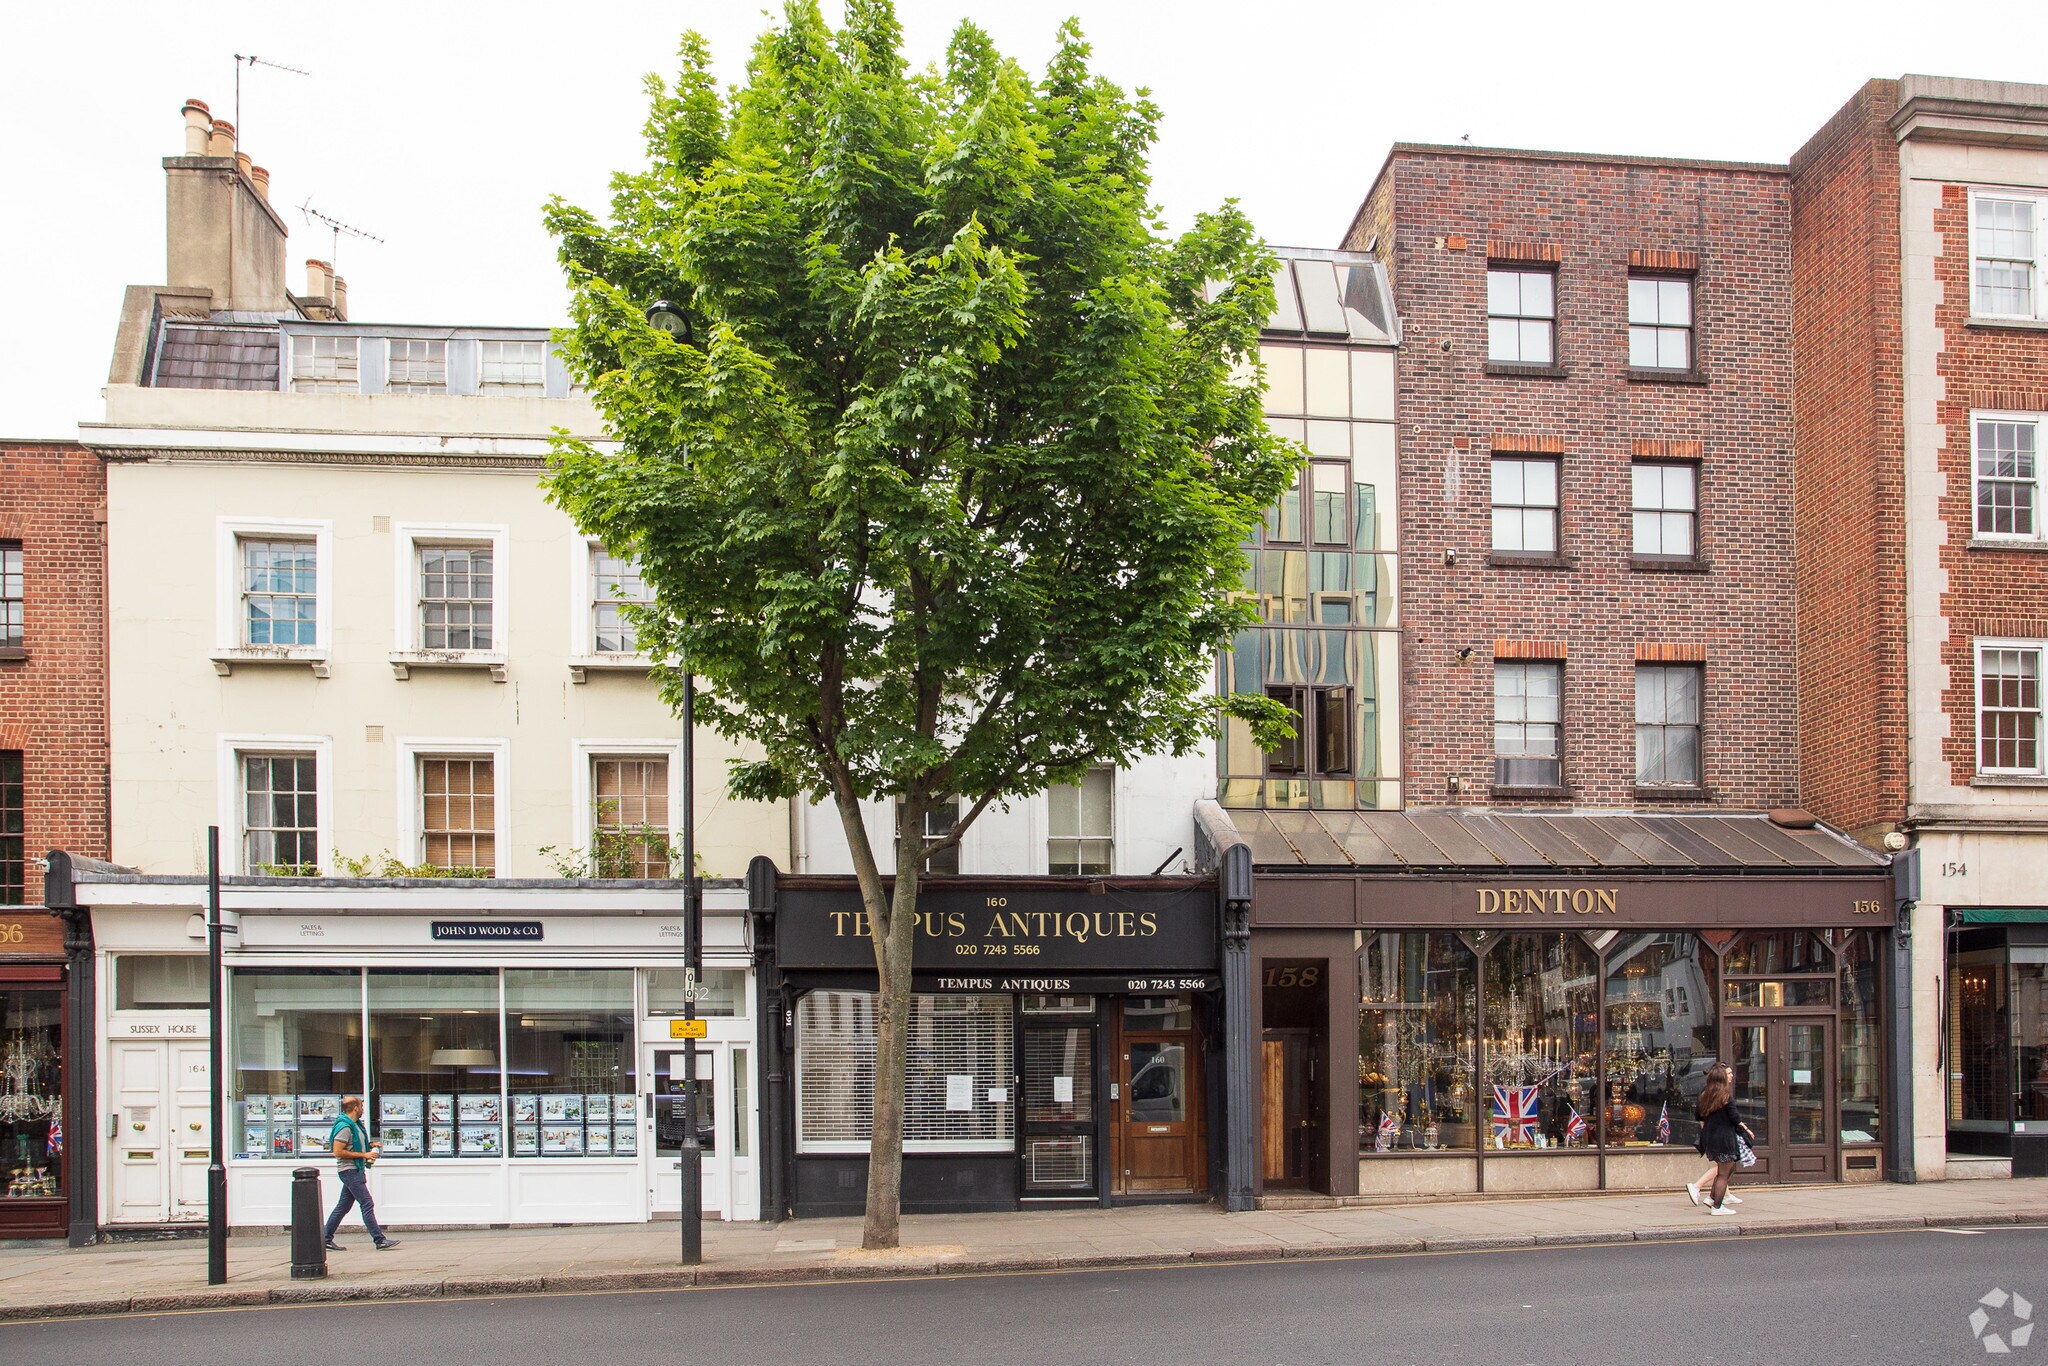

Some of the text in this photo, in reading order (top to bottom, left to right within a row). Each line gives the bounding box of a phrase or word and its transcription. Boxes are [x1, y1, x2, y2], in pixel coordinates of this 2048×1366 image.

[1942, 862, 1967, 877] 154
[986, 897, 1007, 907] 160
[1476, 888, 1619, 914] DENTON
[1853, 900, 1880, 913] 156
[436, 926, 466, 936] JOHN
[469, 926, 477, 935] D
[479, 926, 511, 935] WOOD
[512, 926, 521, 935] &
[829, 911, 1157, 943] TEUS ANTIQUES
[955, 944, 1041, 955] 020 7243 5566
[1262, 967, 1320, 987] 158
[938, 978, 1071, 991] TEMPUS ANTIQUES
[1128, 979, 1205, 990] 020 7243 5566
[130, 1025, 197, 1033] SUSSEX HOUSE
[1151, 1056, 1165, 1064] 160
[188, 1065, 206, 1073] 164
